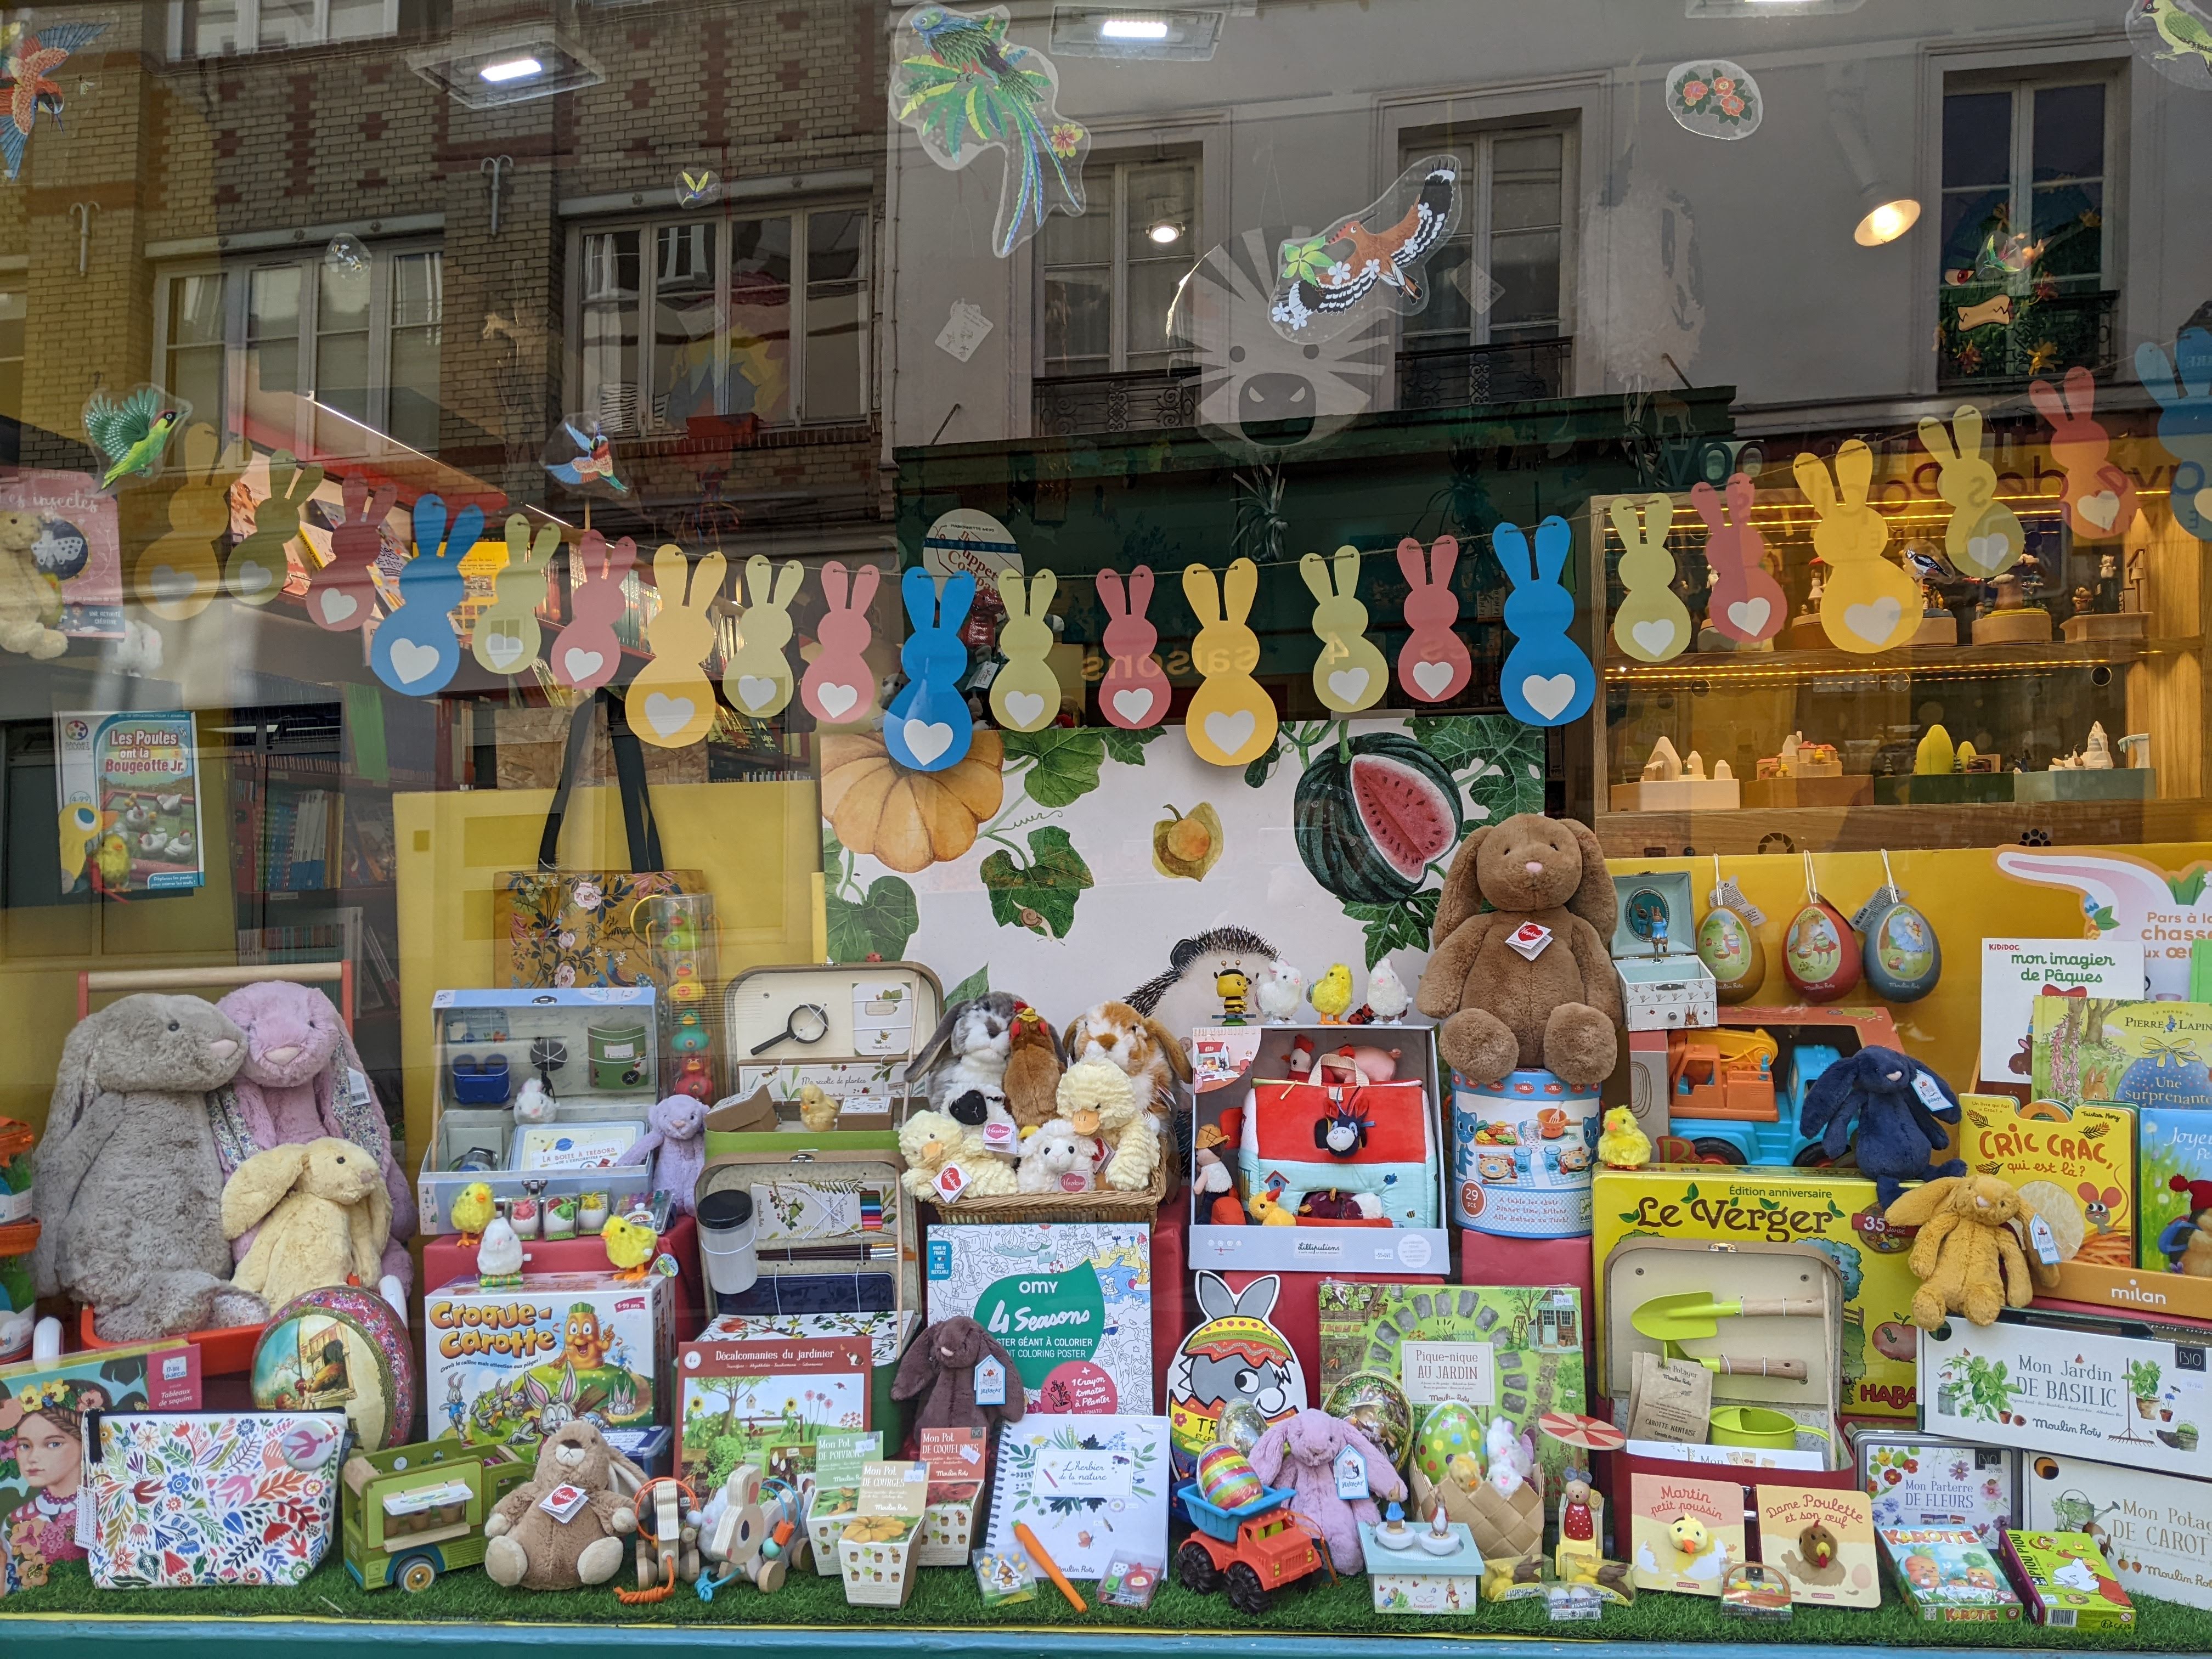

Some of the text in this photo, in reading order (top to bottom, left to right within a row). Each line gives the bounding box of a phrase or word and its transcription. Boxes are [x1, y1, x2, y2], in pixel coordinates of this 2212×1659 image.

[33, 490, 98, 513] insectes
[962, 549, 997, 582] uppet
[111, 730, 177, 746] Les Poules
[120, 748, 150, 758] ont la
[105, 759, 168, 775] Bougeotte
[2147, 912, 2197, 923] Pars à
[2011, 952, 2115, 969] mon imagier
[2021, 968, 2103, 986] de Pâques
[2125, 1017, 2212, 1031] PIERRE LAPIN
[844, 1076, 866, 1088] plantes
[2155, 1077, 2182, 1088] Une
[2105, 1113, 2120, 1122] Mory
[586, 1148, 615, 1156] TRÉSORS
[2007, 1160, 2057, 1173] qui est
[1466, 1188, 1478, 1200] 29
[1729, 1184, 1832, 1199] Édition anniversaire
[1638, 1197, 1833, 1243] Le Verger
[1864, 1216, 1885, 1231] 35
[1298, 1242, 1340, 1254] Lilliputiens
[2111, 1279, 2167, 1305] milan
[988, 1300, 1090, 1334] 4 Seasons
[439, 1327, 557, 1359] carotte
[1018, 1335, 1093, 1347] GÉANT À COLORIER
[715, 1348, 834, 1361] Décalcomanies du jardinier
[1018, 1349, 1055, 1358] COLORING
[1057, 1350, 1086, 1358] POSTER
[1416, 1349, 1478, 1363] Pique-nique
[2180, 1351, 2201, 1366] BIO
[440, 1362, 455, 1373] Gravis
[490, 1361, 513, 1369] attention
[523, 1359, 539, 1370] pièges
[1418, 1366, 1478, 1379] AU JARDIN
[1657, 1361, 1697, 1378] Mon Potager
[2019, 1355, 2112, 1382] Mon Jardin
[1077, 1376, 1105, 1387] Crayon
[1663, 1374, 1681, 1383] Moulin
[161, 1389, 190, 1398] Tableaux
[1075, 1387, 1105, 1397] tomates
[1457, 1394, 1470, 1402] Roty
[1860, 1384, 1916, 1409] HABA
[2016, 1376, 2117, 1408] DE BASILIC
[168, 1396, 193, 1404] sequins
[1075, 1397, 1111, 1408] à Planter
[1646, 1418, 1696, 1436] CAROTTE NANTAISE
[2033, 1418, 2101, 1438] Moulin Roty
[819, 1439, 836, 1449] Mon
[923, 1433, 939, 1442] Mon
[922, 1444, 932, 1453] DE
[819, 1452, 828, 1460] DE
[1701, 1455, 1724, 1465] Mon
[1979, 1454, 1997, 1465] BIO
[864, 1465, 881, 1476] Mon
[1063, 1460, 1105, 1471] L'herbier
[862, 1478, 905, 1487] DE COURGES
[1078, 1472, 1107, 1480] nature
[1905, 1480, 1973, 1492] Mon Parterre
[1661, 1485, 1711, 1503] Martin
[1905, 1493, 1973, 1508] DE FLEURS
[1651, 1500, 1723, 1520] petit poussin
[1766, 1494, 1864, 1524] Dame Poulette
[2123, 1499, 2158, 1520] Mon
[1785, 1511, 1847, 1529] et son œuf
[1882, 1529, 1979, 1545] KAROTTE
[2112, 1519, 2136, 1541] DE
[2009, 1534, 2040, 1577] PIOU PIOU
[1081, 1565, 1094, 1573] Roty
[2145, 1565, 2193, 1584] Moulin
[1944, 1607, 1998, 1621] KAROTTE
